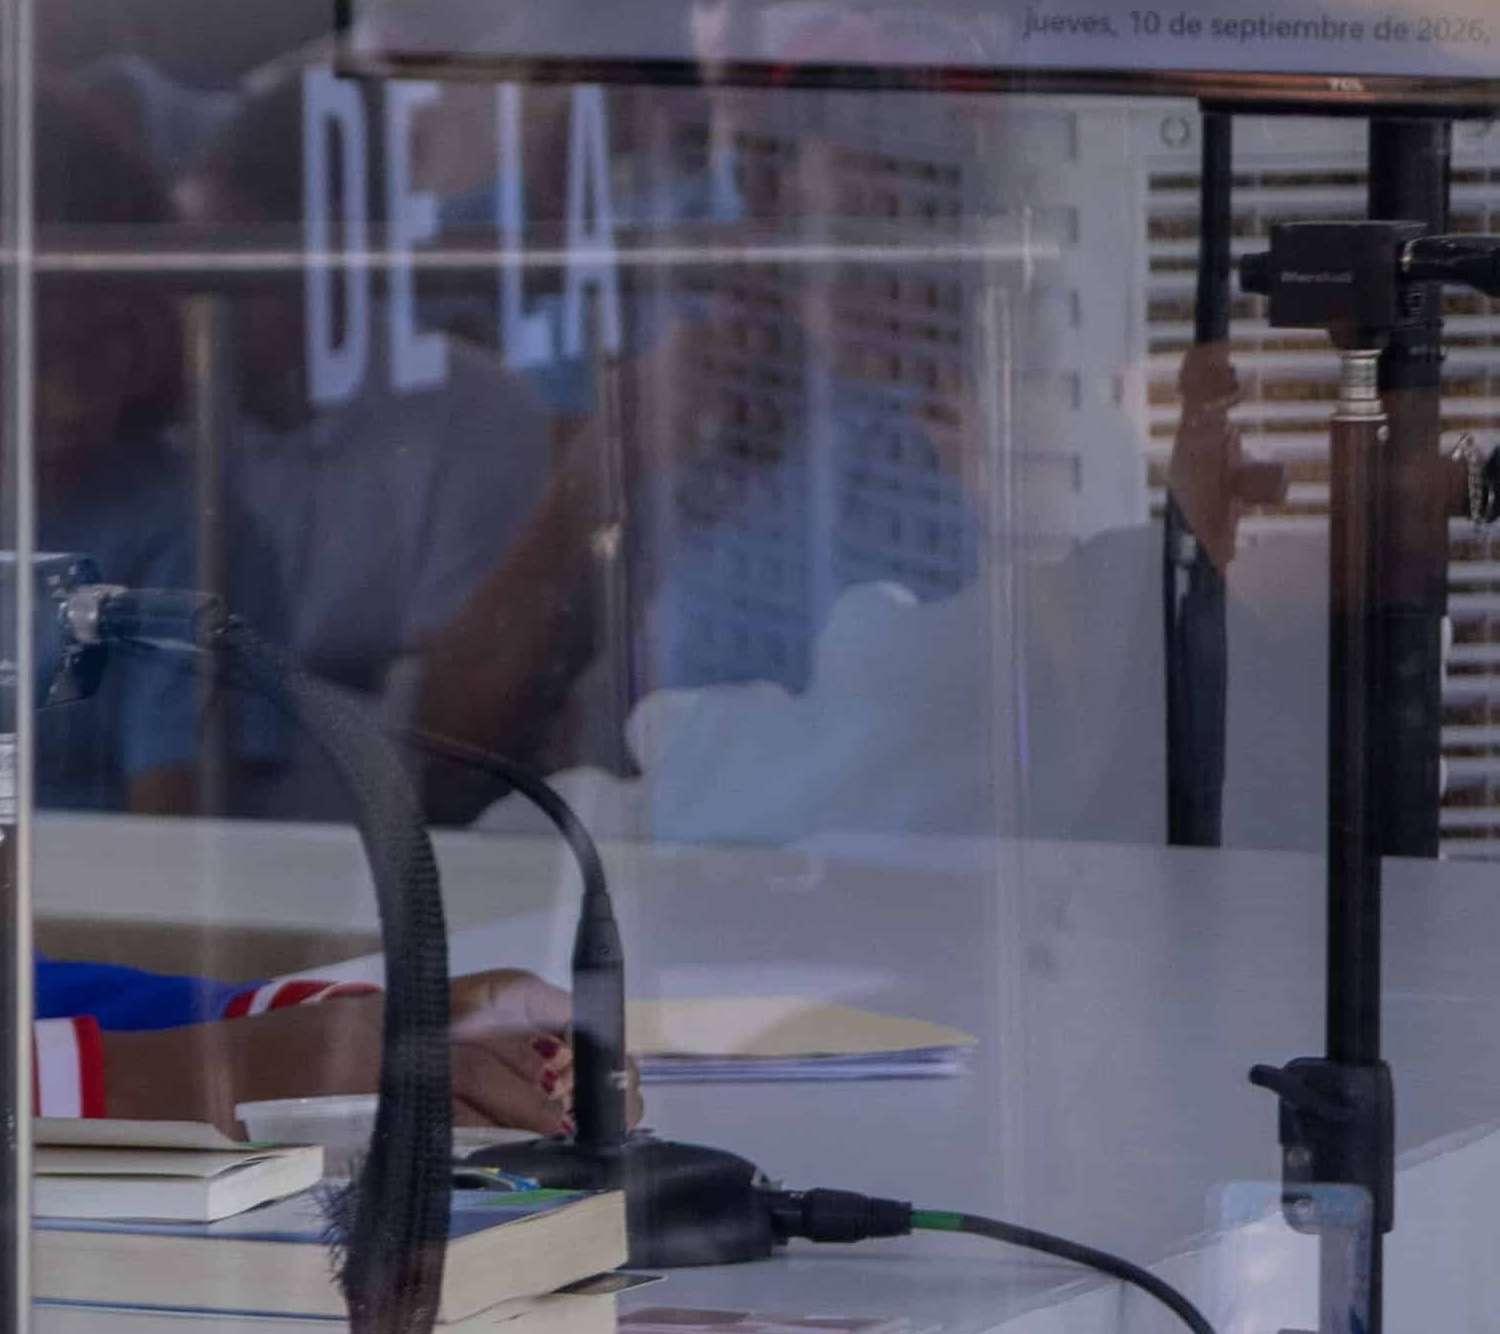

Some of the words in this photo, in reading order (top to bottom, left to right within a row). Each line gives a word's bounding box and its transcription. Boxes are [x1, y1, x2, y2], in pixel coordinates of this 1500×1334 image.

[1021, 4, 1118, 40] jueves,
[1131, 10, 1160, 36] 10
[1168, 10, 1202, 37] de
[1210, 11, 1365, 44] septiembre
[1373, 15, 1409, 43] de
